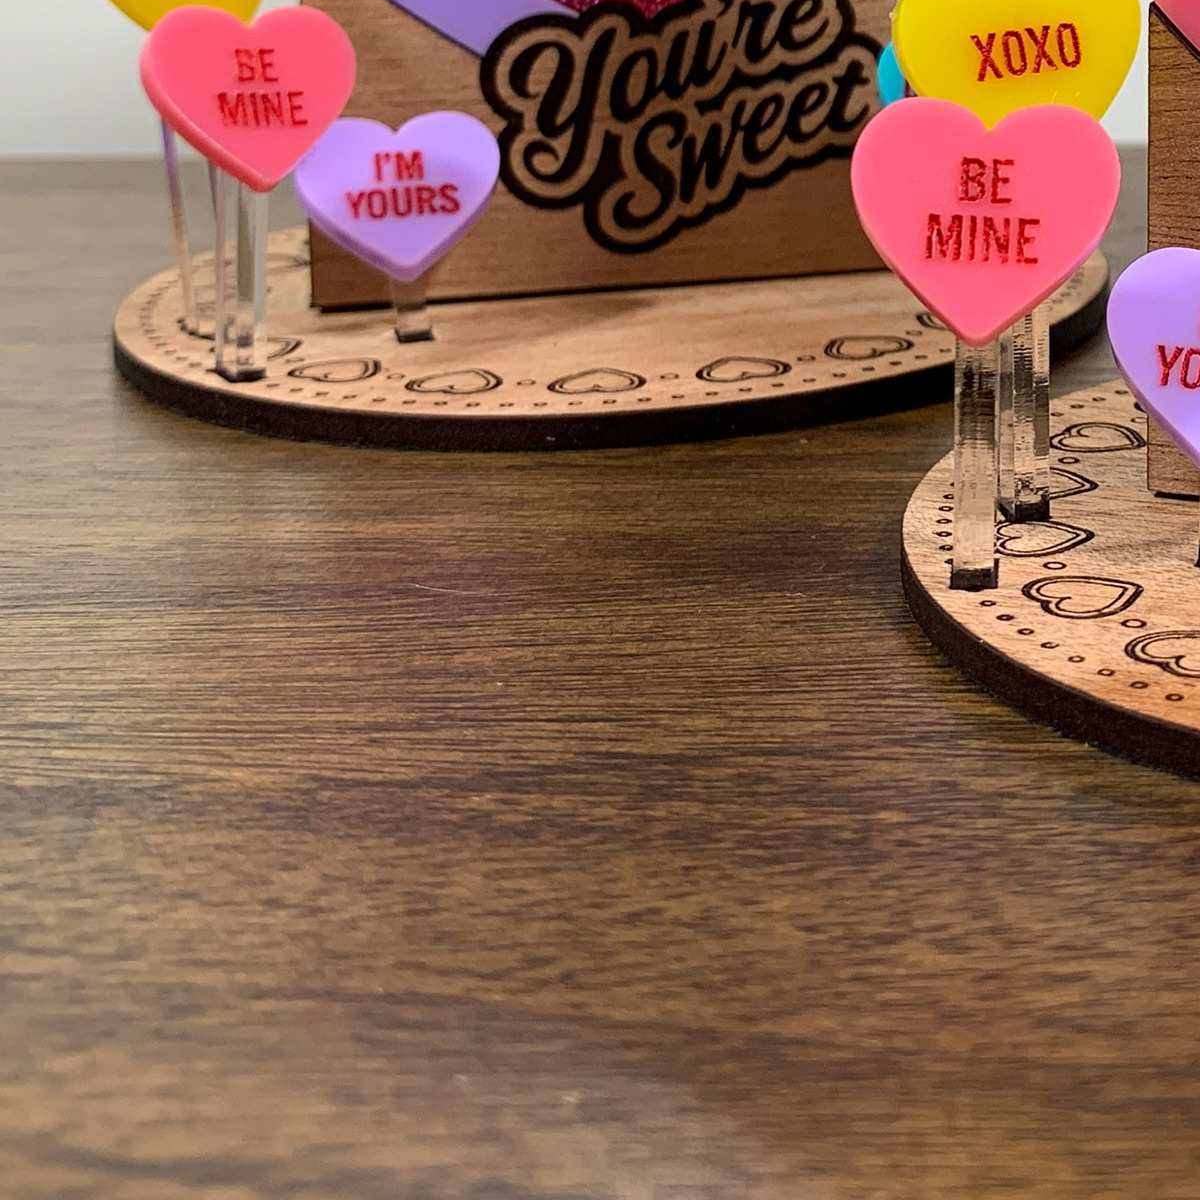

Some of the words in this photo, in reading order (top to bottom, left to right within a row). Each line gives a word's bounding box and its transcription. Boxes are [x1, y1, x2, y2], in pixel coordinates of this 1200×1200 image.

[234, 48, 278, 83] BE
[971, 22, 1083, 82] XOXO
[216, 91, 308, 127] MINE
[613, 60, 871, 230] Sweet
[374, 150, 424, 182] I'M
[958, 157, 1015, 204] BE
[344, 184, 461, 220] YOURS
[925, 213, 1040, 265] MINE
